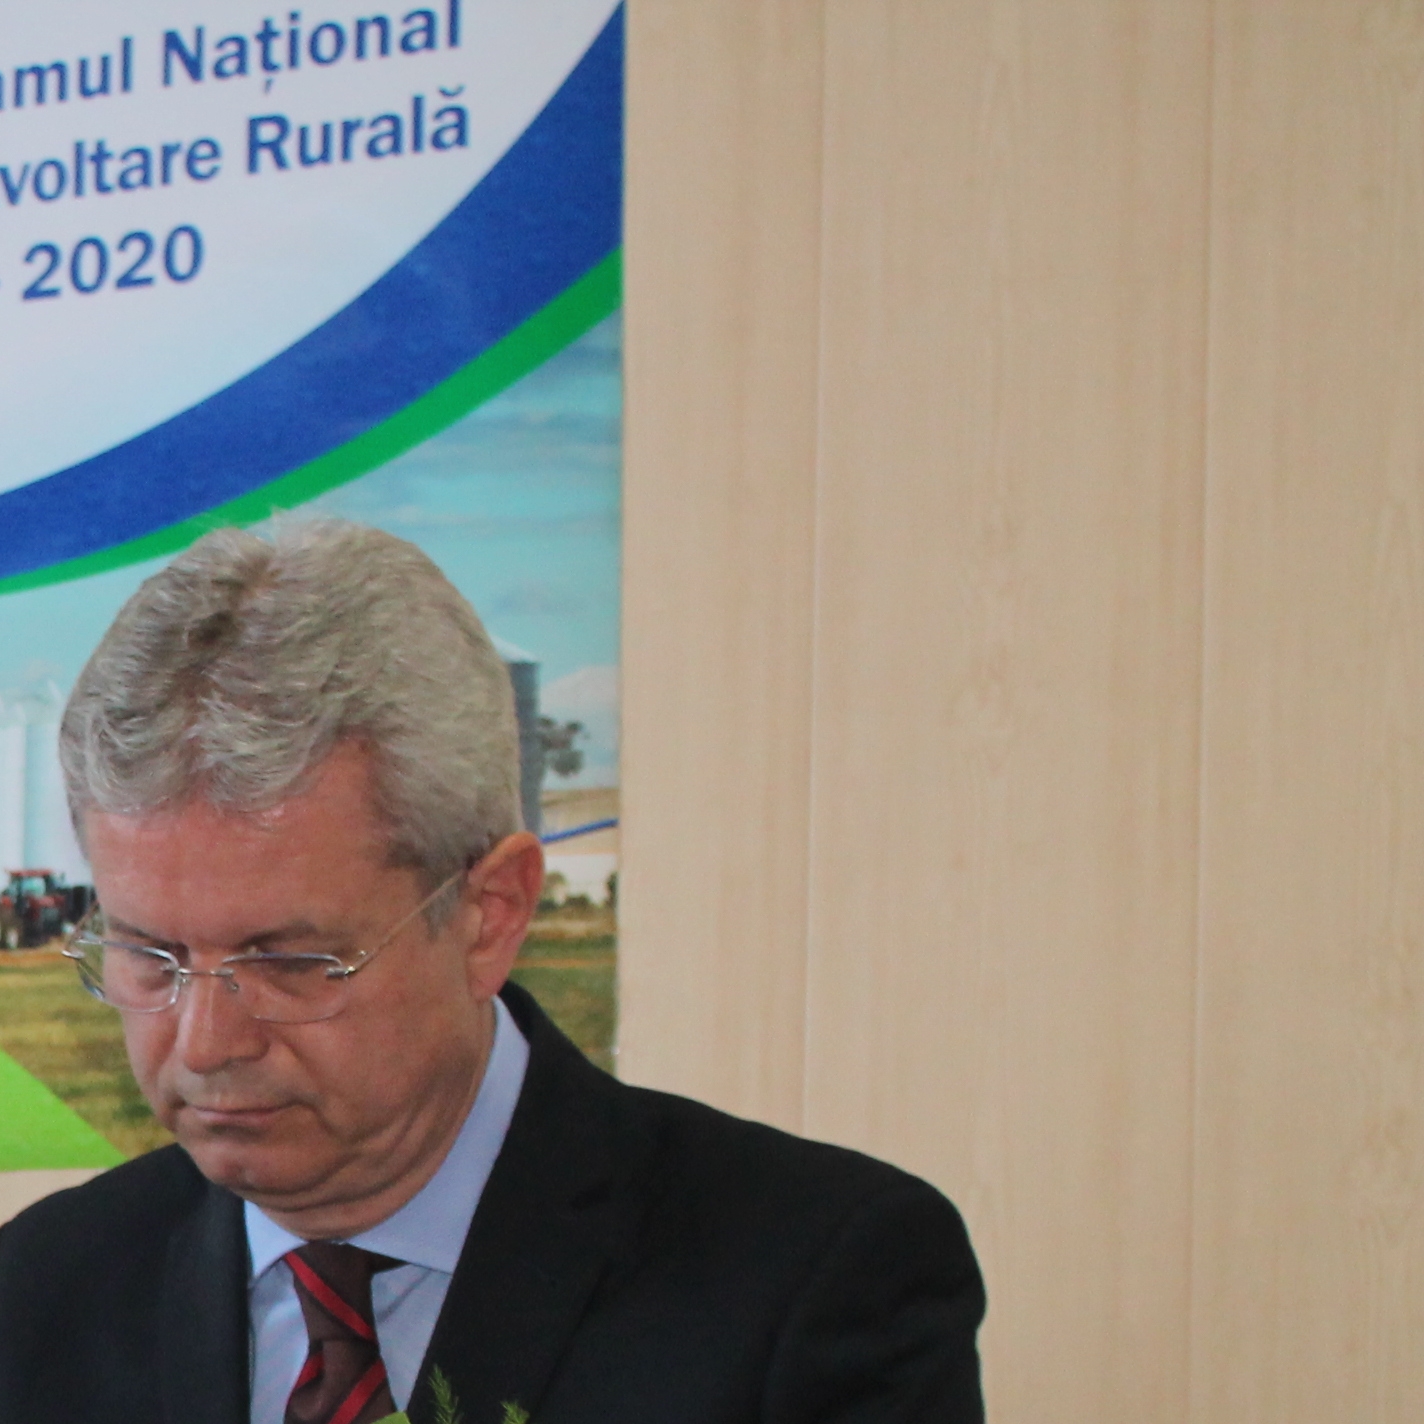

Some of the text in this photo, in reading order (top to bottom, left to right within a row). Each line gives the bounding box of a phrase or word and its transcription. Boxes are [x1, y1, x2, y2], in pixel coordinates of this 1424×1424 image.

[160, 0, 465, 95] Național
[245, 86, 472, 176] Rurală
[21, 223, 205, 303] 2020
